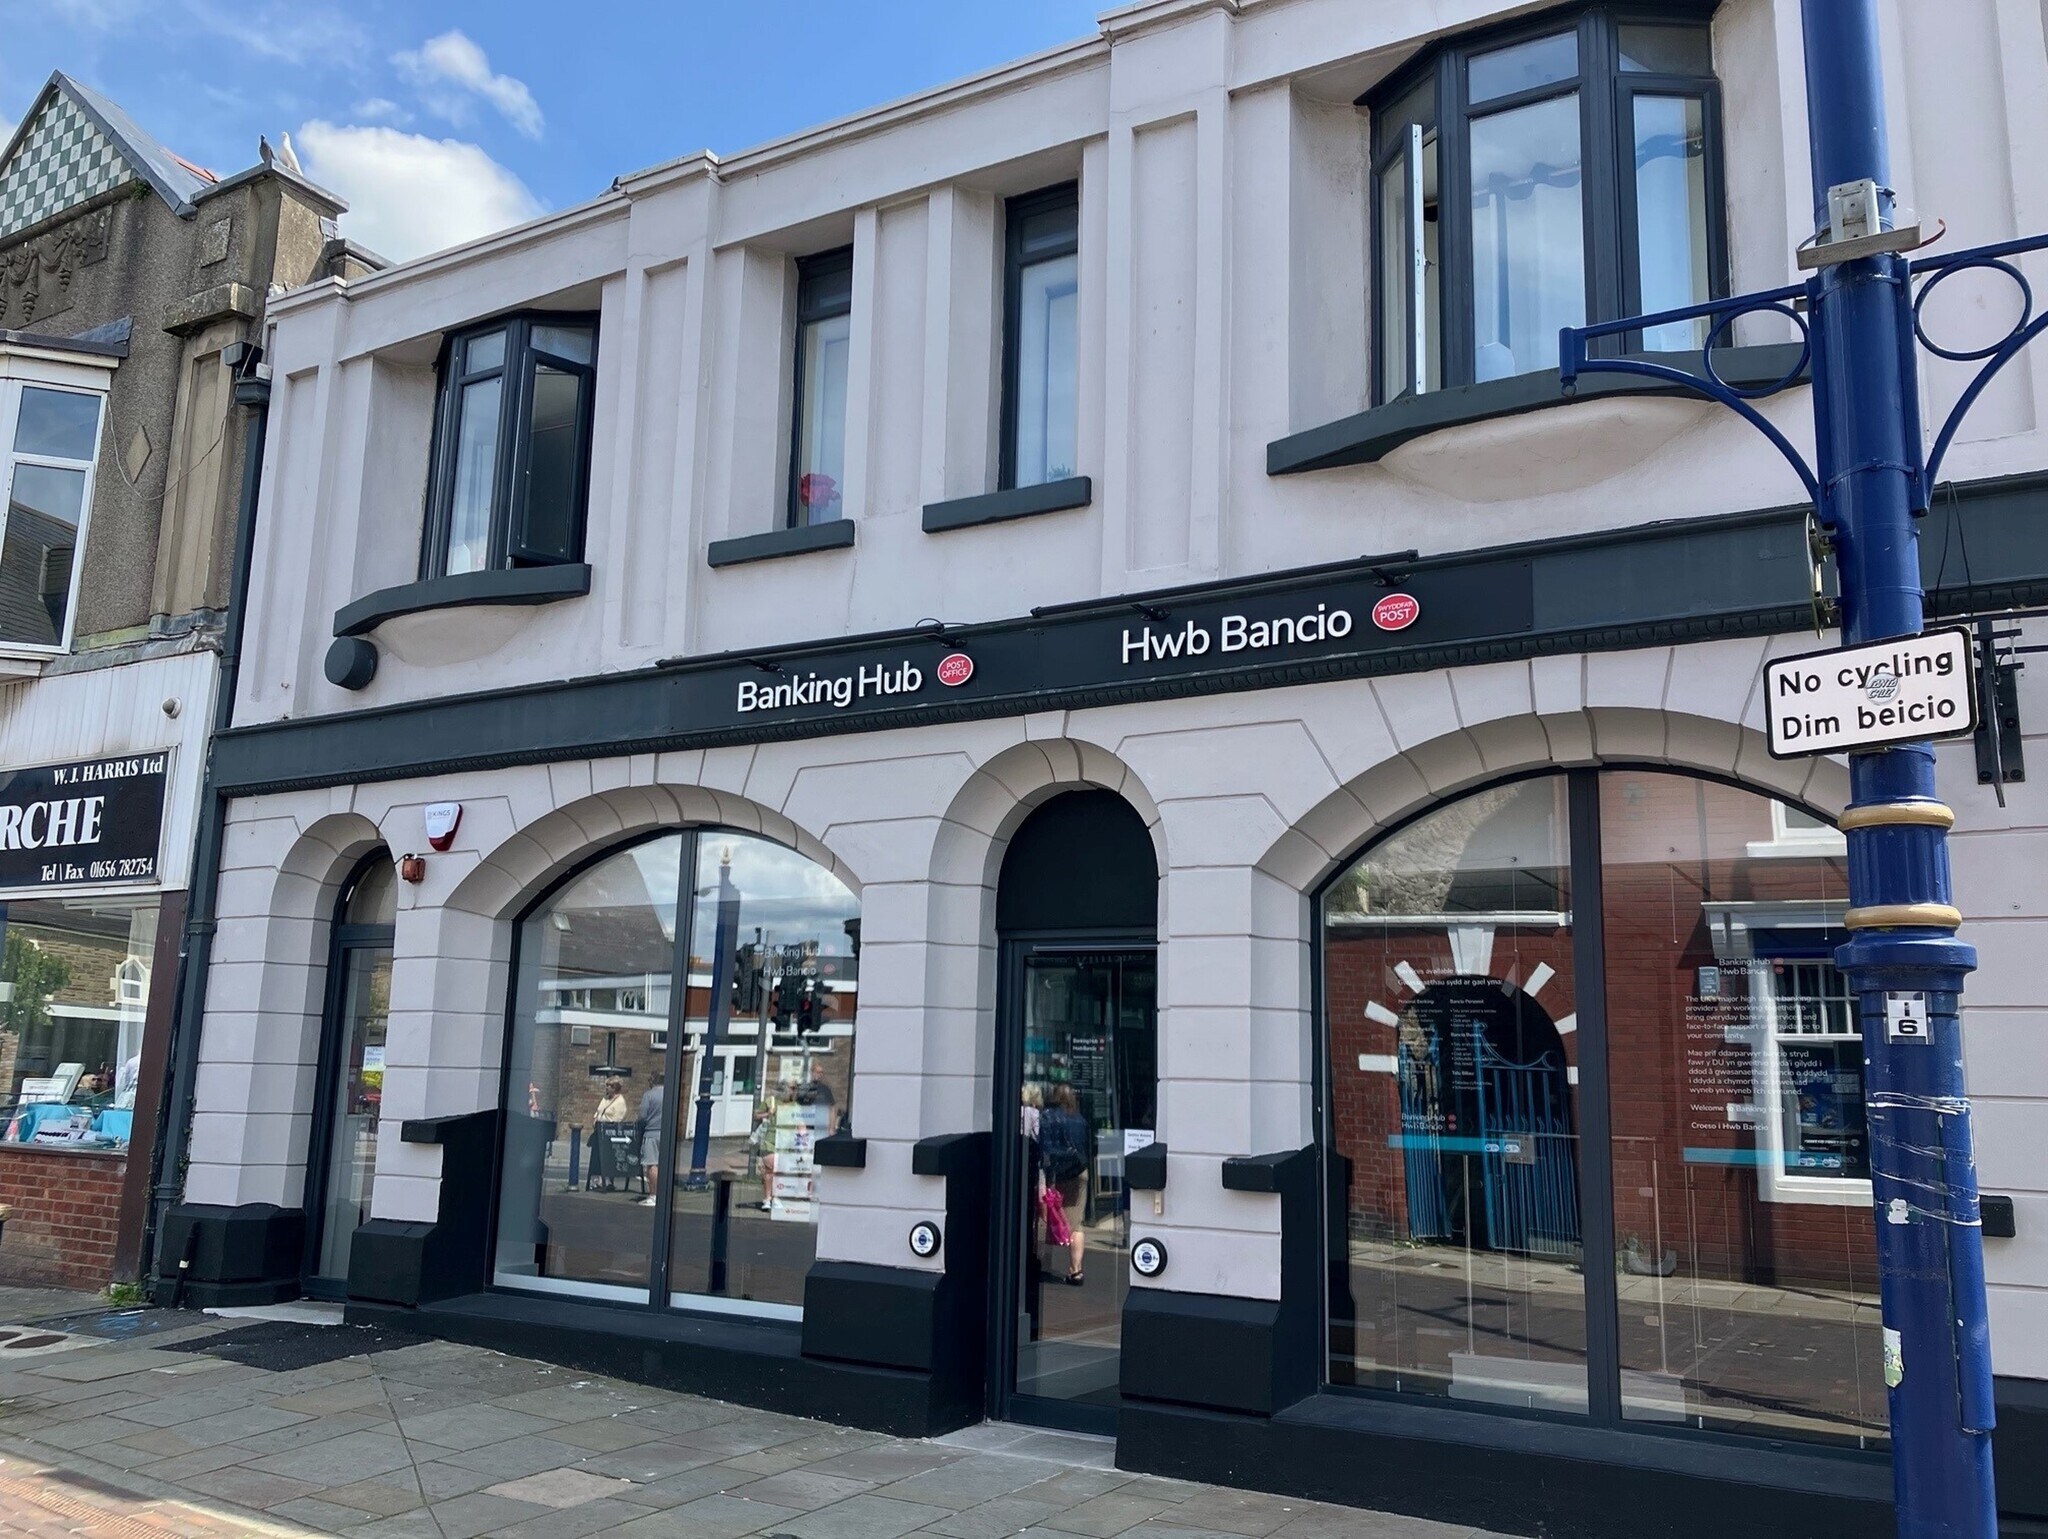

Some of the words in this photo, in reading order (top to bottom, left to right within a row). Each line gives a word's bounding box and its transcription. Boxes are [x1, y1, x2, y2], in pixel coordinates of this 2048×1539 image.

[1380, 608, 1411, 622] POST
[1122, 620, 1210, 663] Hwb
[1221, 603, 1352, 652] Bancio
[946, 660, 966, 670] POST
[941, 667, 968, 678] OFFICE
[1780, 671, 1821, 697] No
[1837, 651, 1954, 689] cycling
[737, 672, 852, 712] Banking
[858, 660, 922, 697] Hub
[1782, 714, 1840, 741] Dim
[1858, 695, 1956, 730] beicio
[53, 769, 68, 787] W.
[69, 767, 79, 784] J.
[82, 759, 139, 782] HARRIS
[142, 755, 164, 775] Ltd
[0, 796, 105, 850] RCHE
[41, 864, 57, 881] Tel
[65, 863, 84, 880] Fax
[90, 860, 117, 878] 01656
[118, 857, 153, 876] 782754
[1719, 959, 1752, 967] Banking
[763, 966, 785, 976] Hwb
[1740, 967, 1768, 975] Bancio
[1685, 1004, 1718, 1012] providers
[1686, 1014, 1705, 1022] bring
[1706, 1014, 1738, 1022] everyday
[1898, 1019, 1918, 1034] 6
[1690, 1104, 1724, 1112] Welcome
[1691, 1122, 1717, 1130] Croeso
[1722, 1122, 1741, 1130] Hwb
[1743, 1123, 1769, 1131] Bancio
